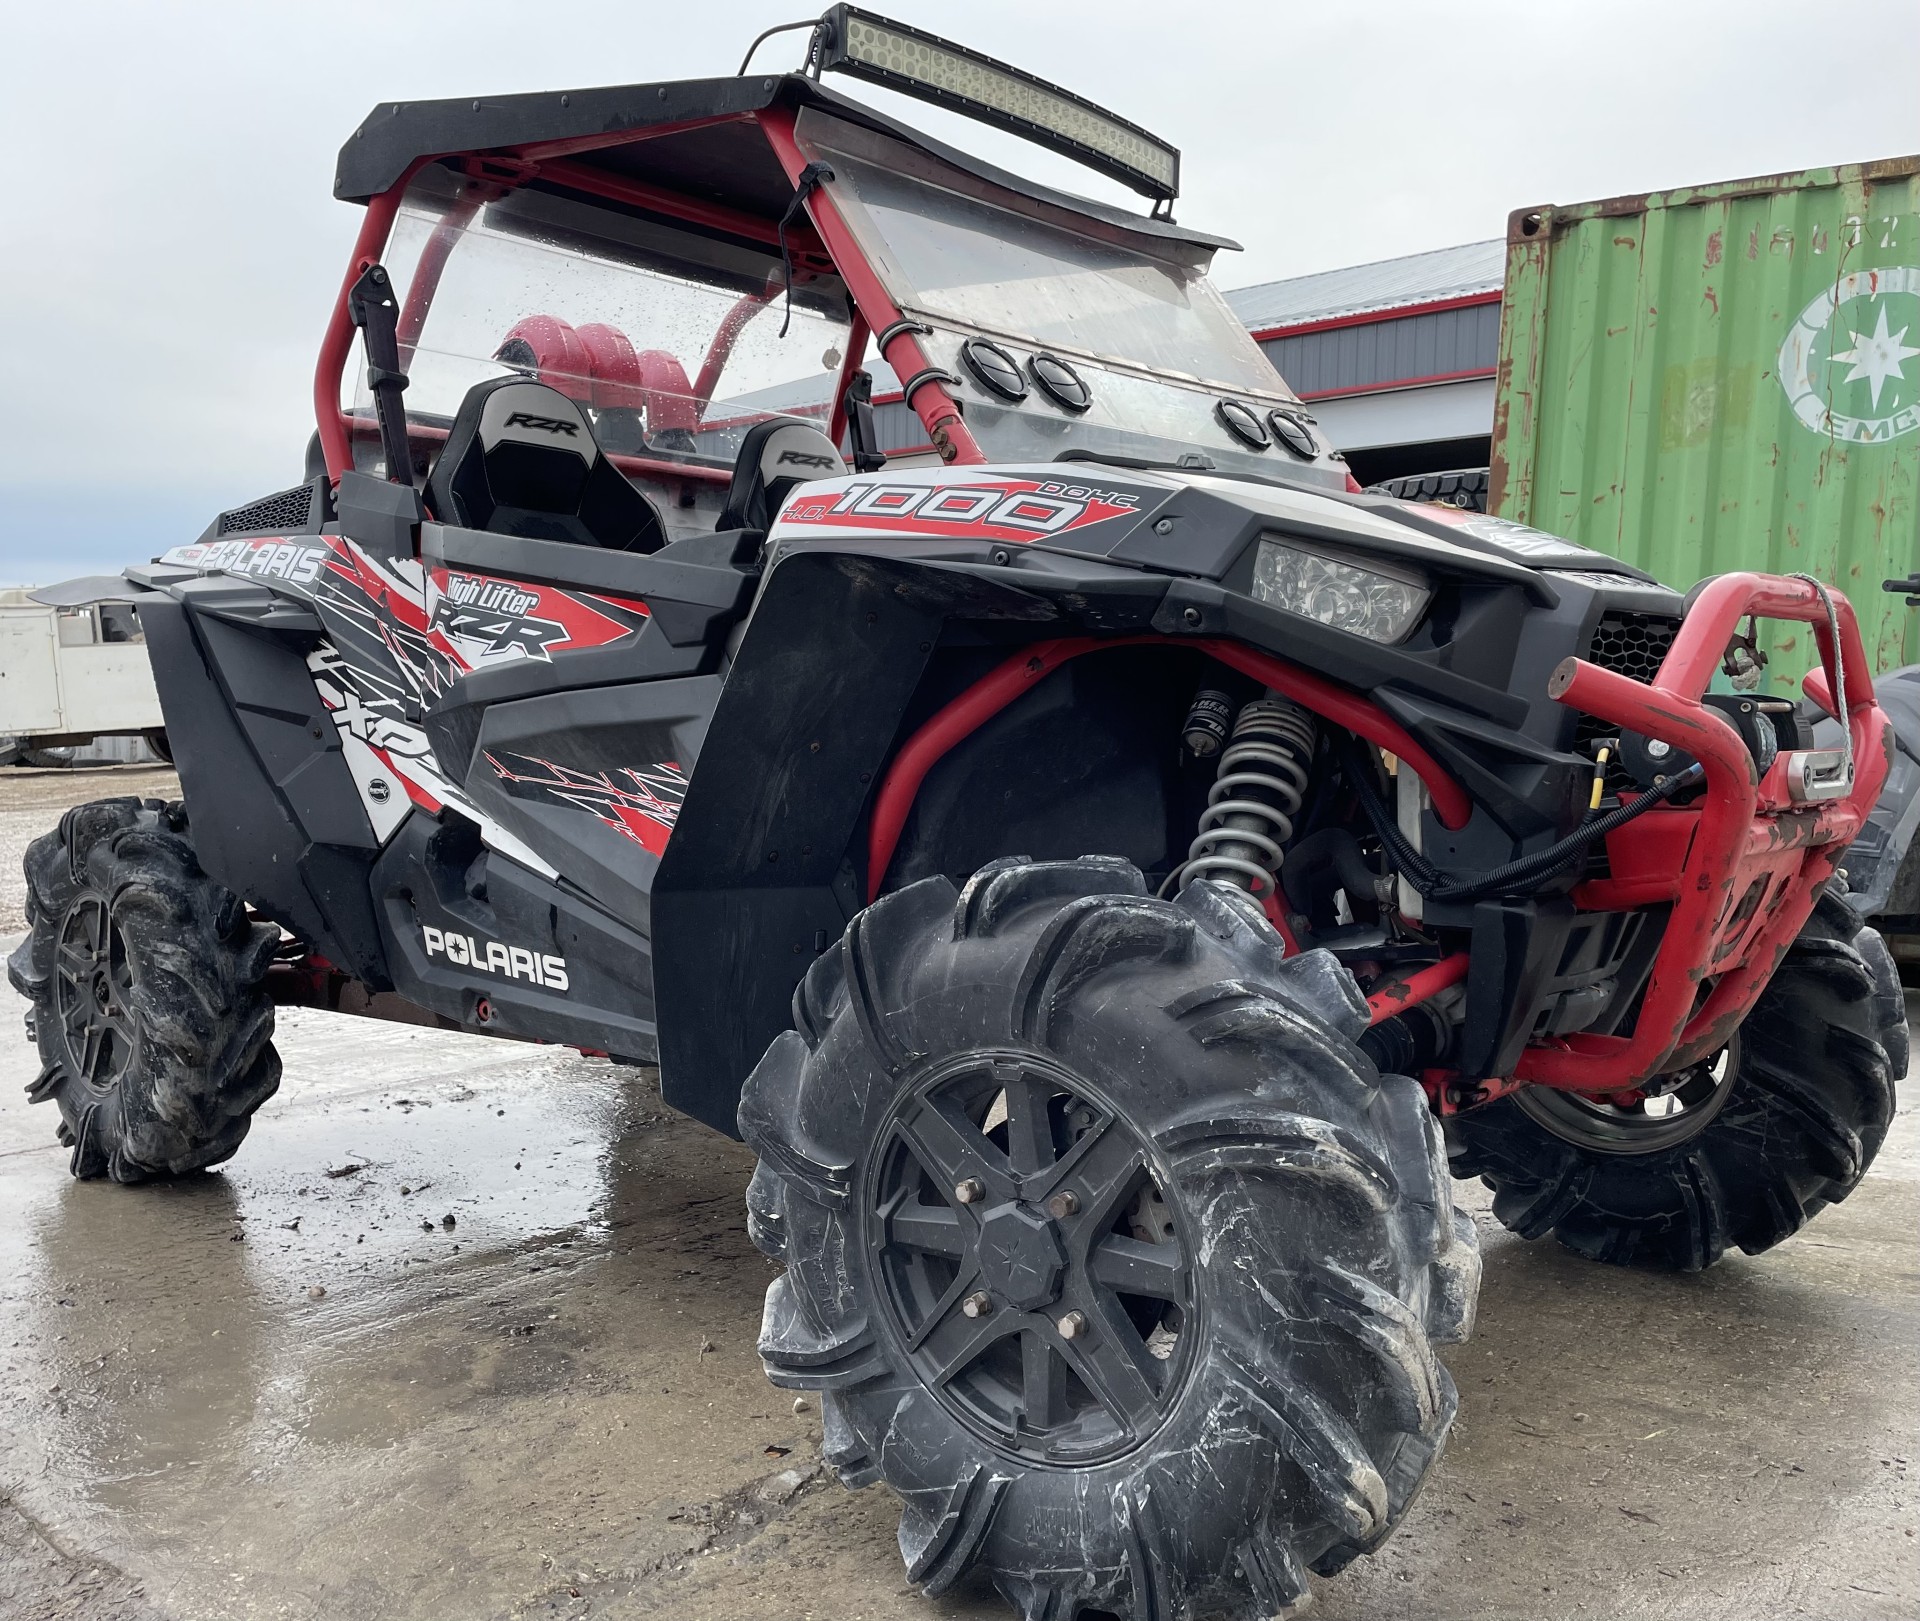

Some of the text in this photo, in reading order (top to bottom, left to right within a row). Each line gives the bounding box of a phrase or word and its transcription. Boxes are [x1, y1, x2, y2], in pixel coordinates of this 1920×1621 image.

[503, 411, 580, 438] RZR
[776, 450, 835, 470] RZR
[827, 483, 1087, 534] 1000
[1036, 481, 1140, 508] DOHC
[202, 541, 327, 584] POLARIS
[478, 583, 538, 615] Lifter
[427, 596, 573, 662] RZR
[422, 925, 570, 991] POLARIS
